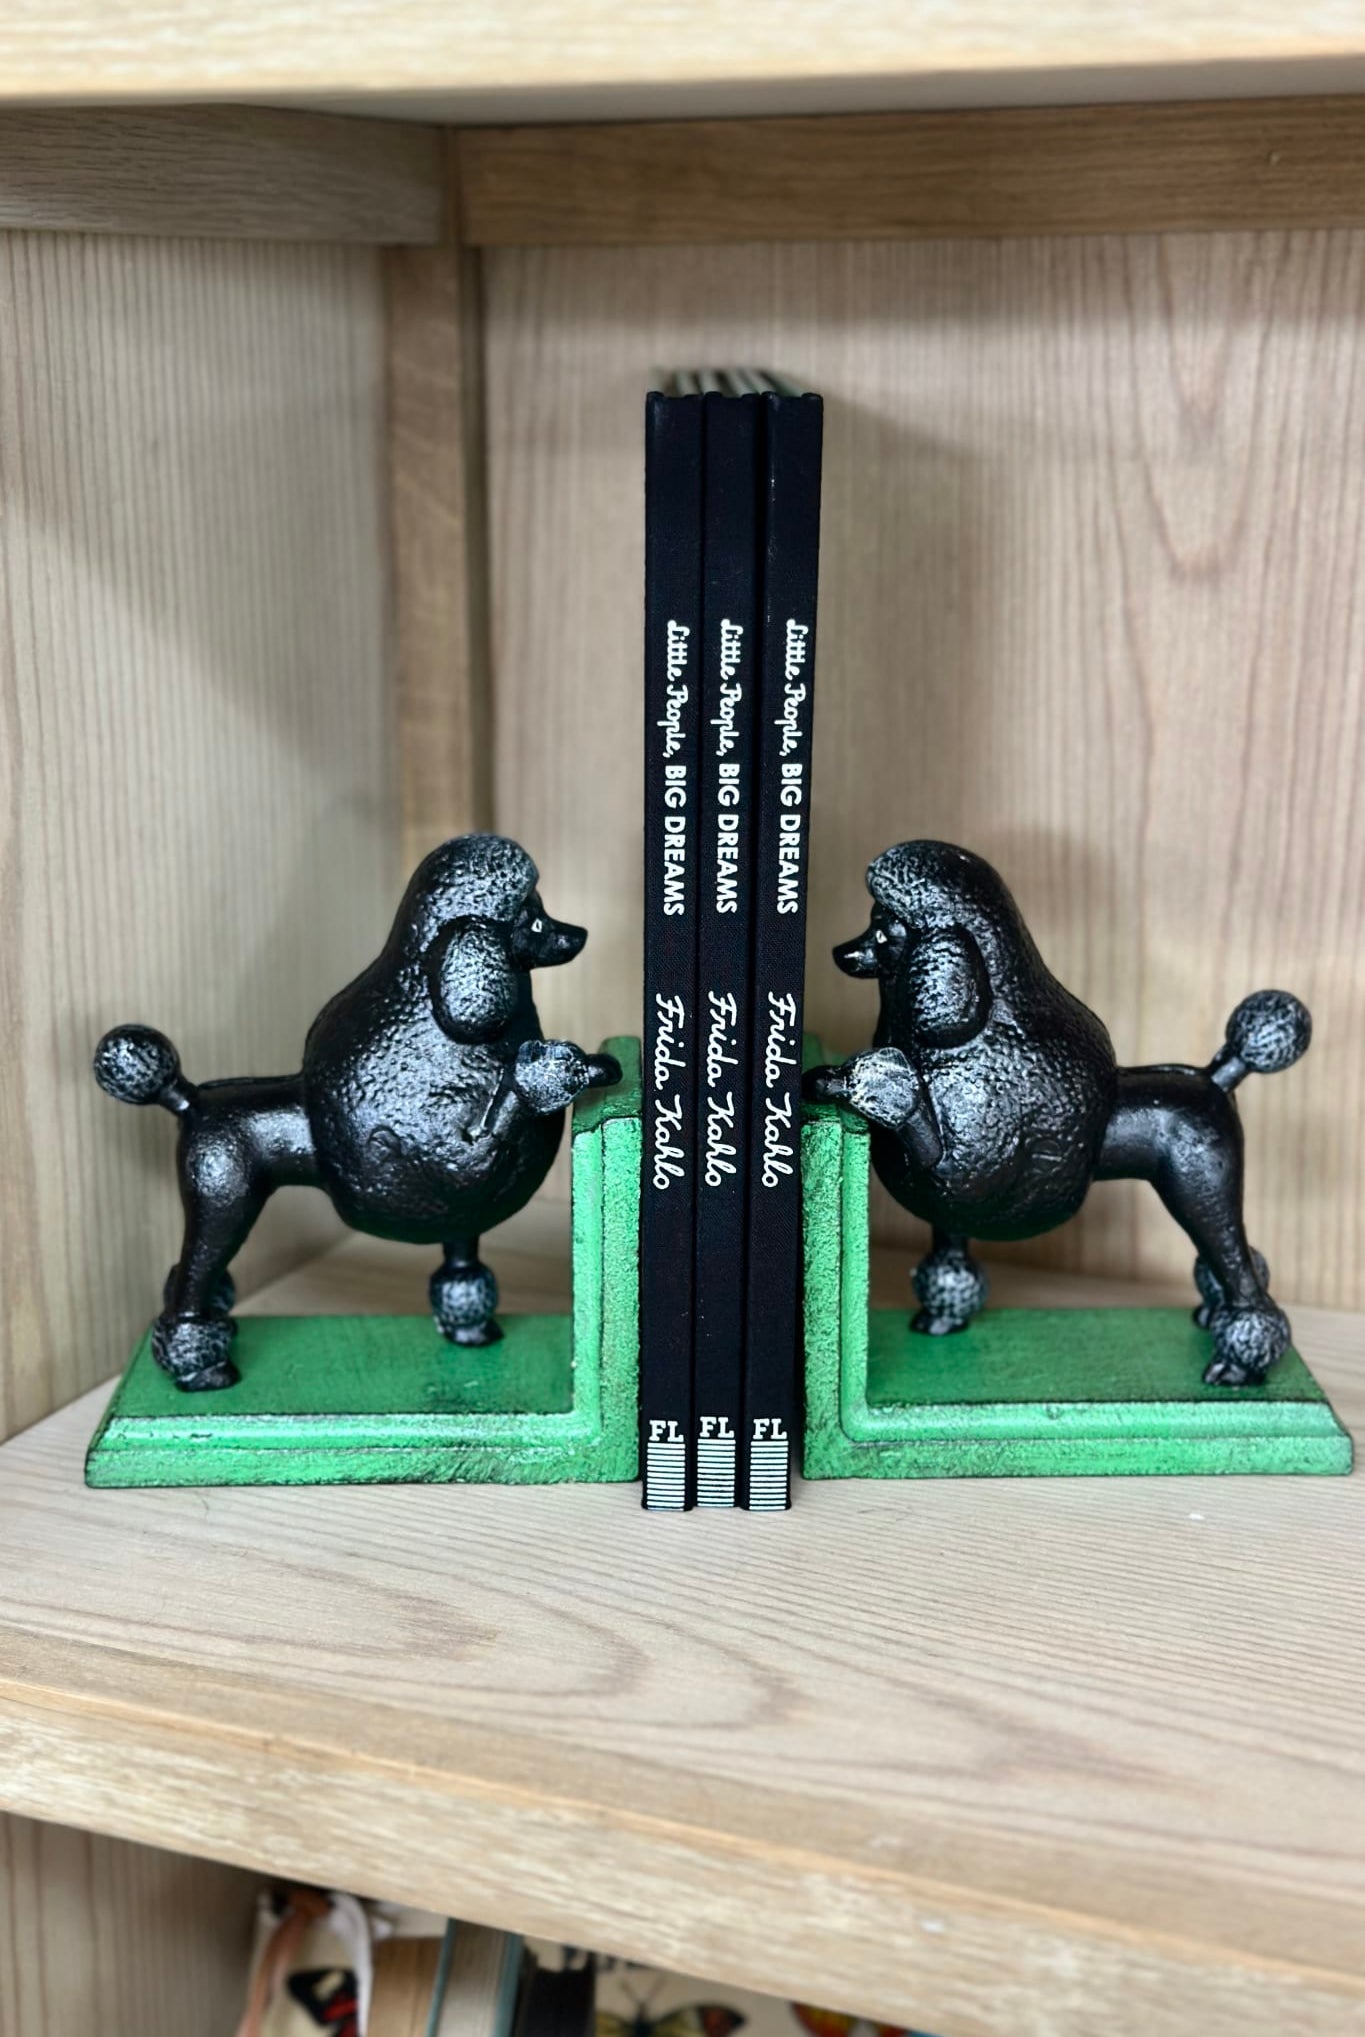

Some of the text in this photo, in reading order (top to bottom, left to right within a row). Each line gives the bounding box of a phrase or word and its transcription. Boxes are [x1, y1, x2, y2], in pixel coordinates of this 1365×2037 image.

[656, 619, 691, 916] Little People, BIG DREAMS
[709, 618, 744, 914] Little People, BIG DREAMS
[773, 618, 809, 915] Little People, BIG DREAMS
[652, 992, 687, 1190] Frida Kahlo
[704, 990, 739, 1187] Frida Kahlo
[761, 991, 797, 1188] Frida Kahlo
[648, 1419, 685, 1443] FL
[699, 1416, 735, 1439] FL
[752, 1417, 788, 1440] FL
